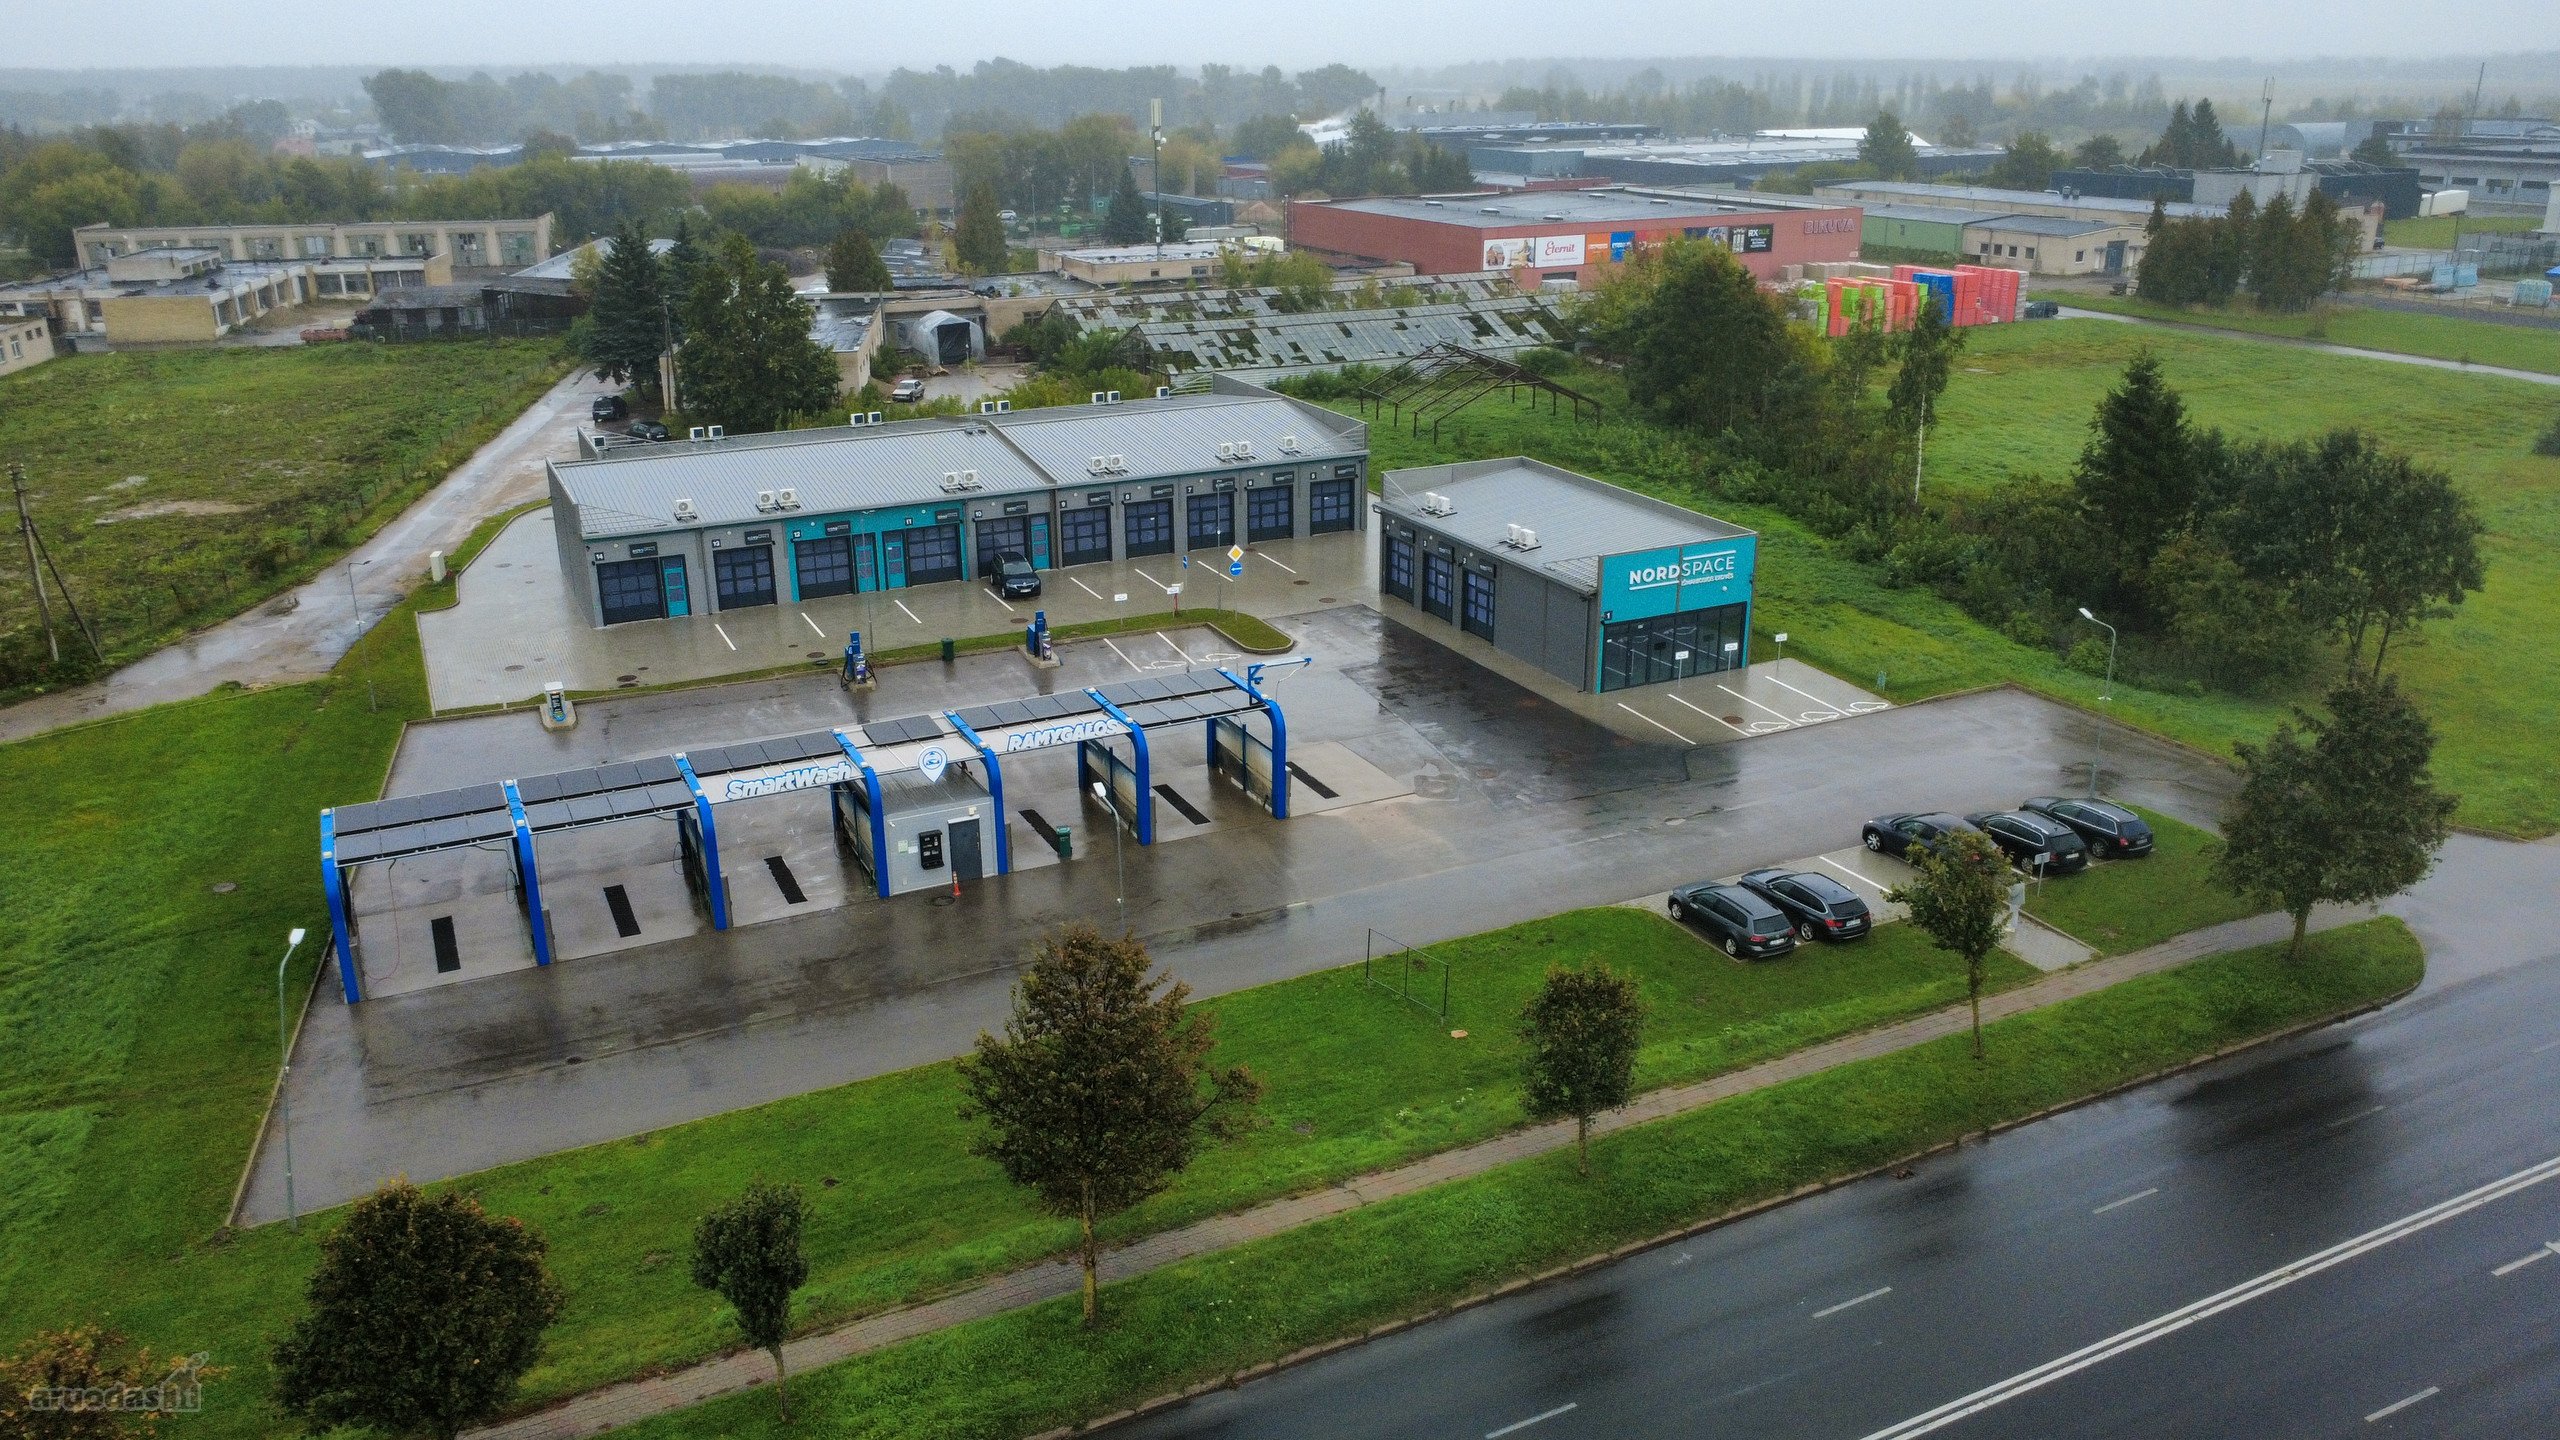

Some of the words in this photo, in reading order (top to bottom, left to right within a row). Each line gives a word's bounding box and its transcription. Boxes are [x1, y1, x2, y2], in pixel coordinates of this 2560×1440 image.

[1803, 218, 1855, 234] BIKUVA
[1545, 240, 1575, 256] Eternit
[1629, 556, 1735, 585] NORDSPACE
[1008, 718, 1119, 752] RAMYGALOS
[725, 761, 853, 800] SmartWash
